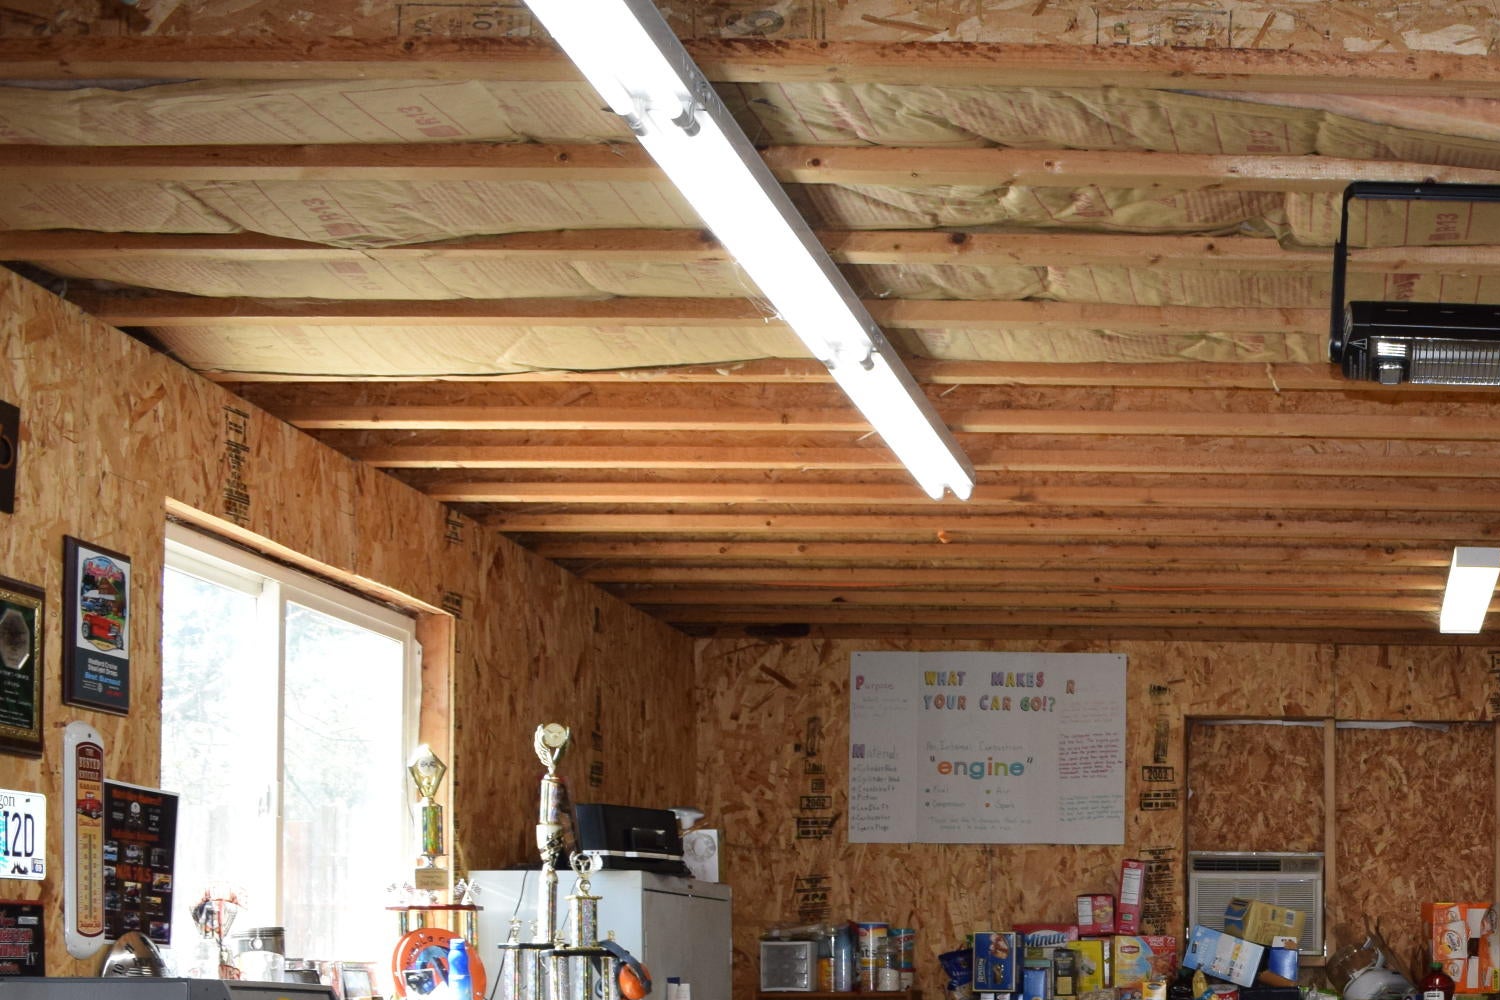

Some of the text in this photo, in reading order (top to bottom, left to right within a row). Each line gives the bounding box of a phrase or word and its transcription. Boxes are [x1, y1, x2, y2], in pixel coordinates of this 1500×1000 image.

[924, 670, 967, 687] WHAT
[990, 671, 1045, 688] MAKES
[923, 694, 968, 711] YOUR
[979, 694, 1012, 712] CAR
[1019, 695, 1057, 712] GO!?
